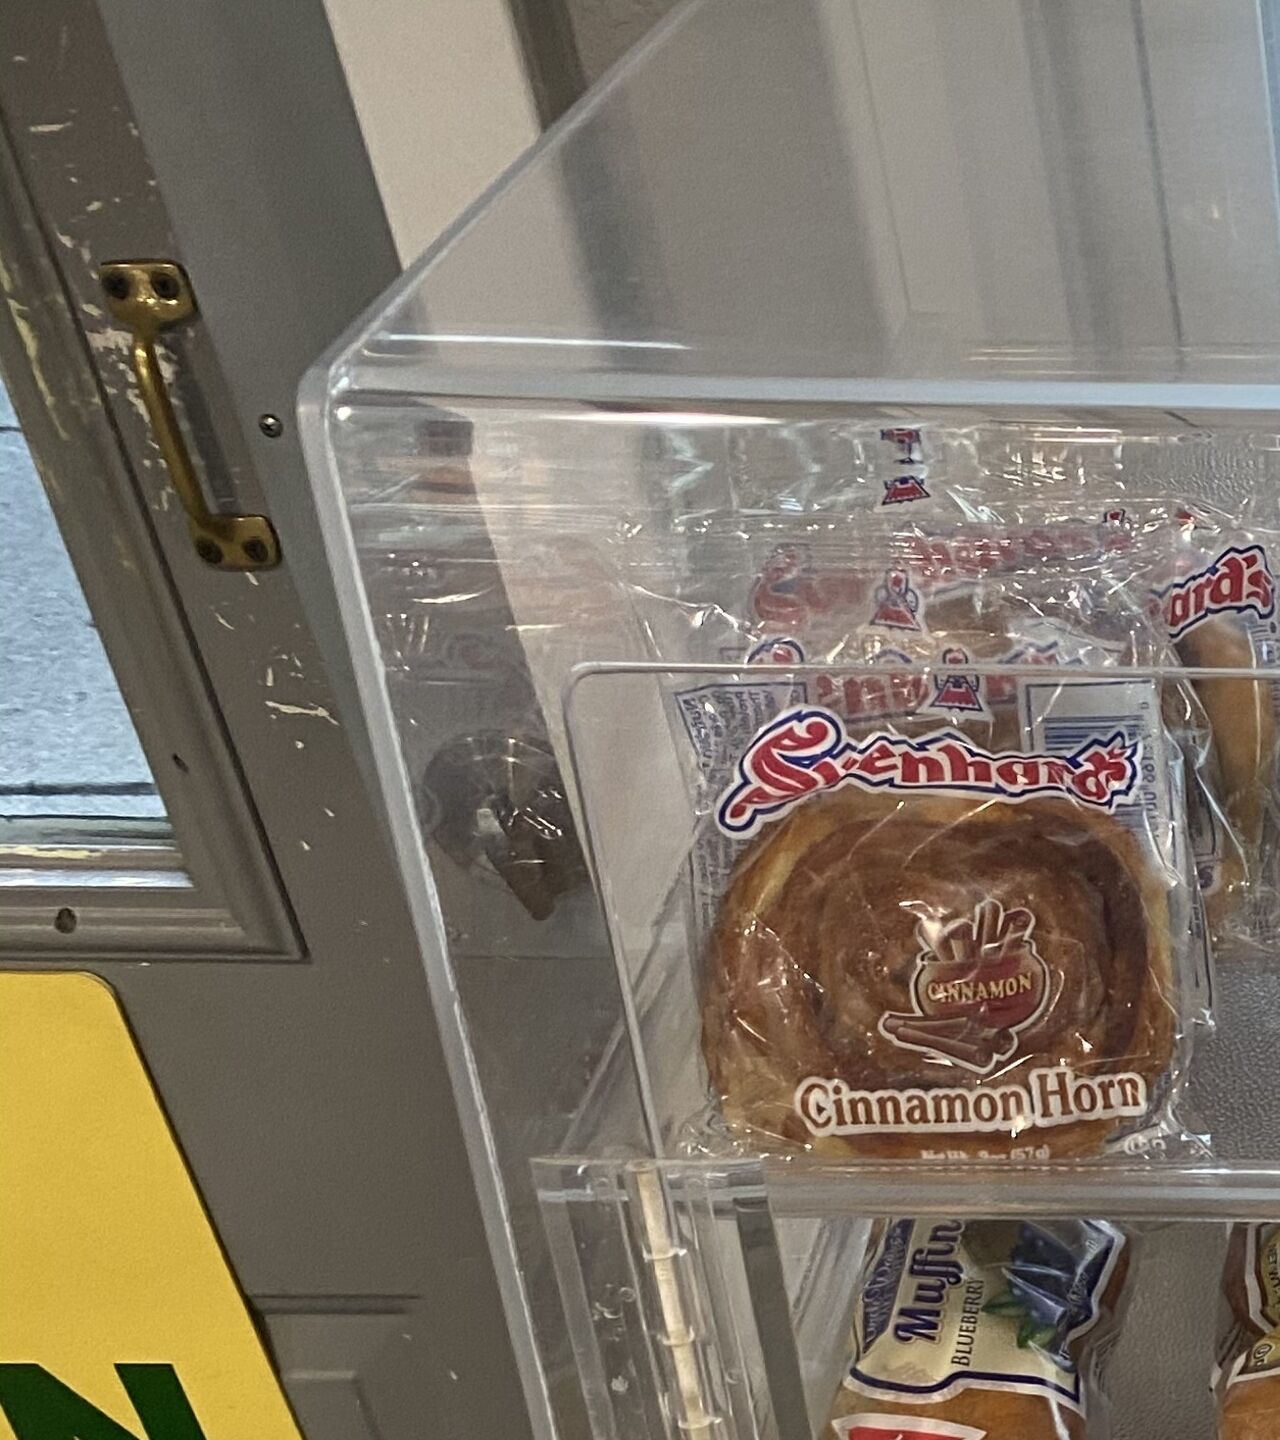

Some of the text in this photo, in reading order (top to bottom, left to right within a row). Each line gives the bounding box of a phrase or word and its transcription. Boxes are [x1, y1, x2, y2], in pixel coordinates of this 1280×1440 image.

[927, 972, 1033, 1003] CINNAMON
[800, 1071, 1142, 1129] Cinnamon Horn
[950, 1276, 984, 1367] BLUEBERRY
